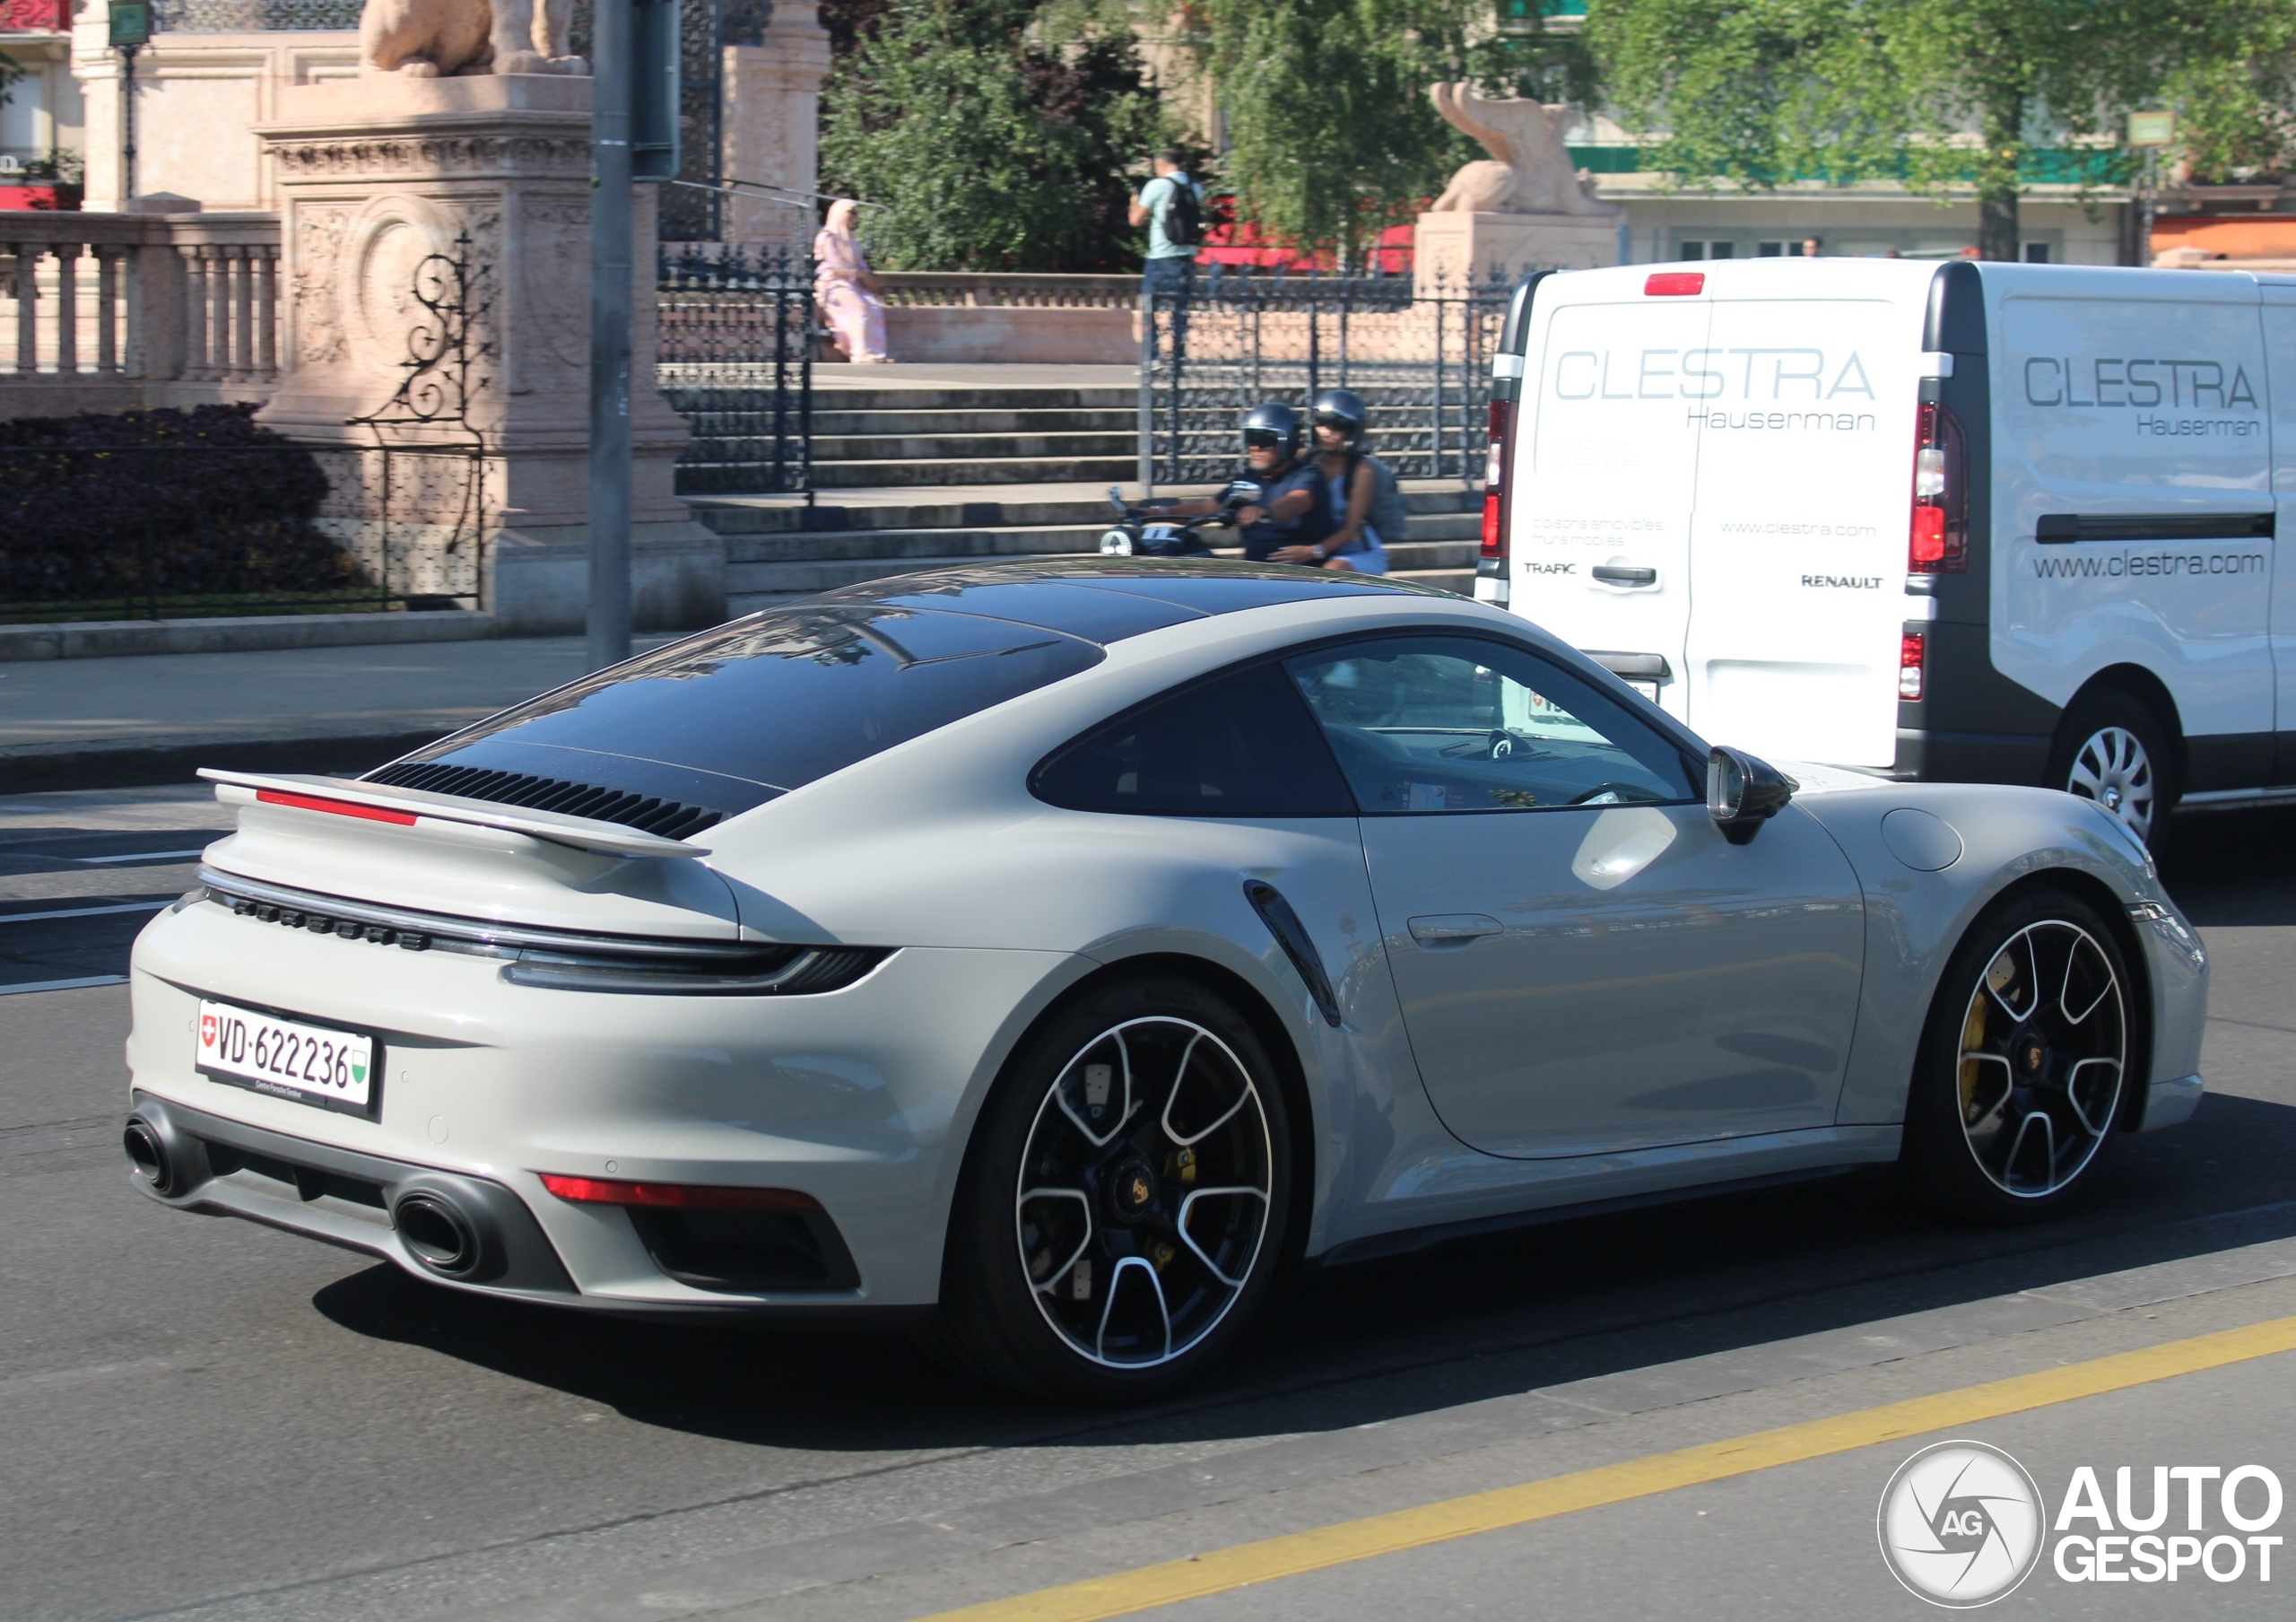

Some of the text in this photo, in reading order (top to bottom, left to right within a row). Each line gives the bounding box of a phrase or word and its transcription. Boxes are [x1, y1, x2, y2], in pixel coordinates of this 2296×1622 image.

[1555, 348, 1876, 401] CLESTRA
[2024, 357, 2258, 408] CLESTRA
[1687, 406, 1876, 431] Hauserman
[2136, 414, 2261, 436] Hauserman
[1590, 518, 1664, 530] amovibles
[1720, 521, 1876, 536] www.clestra.com
[1532, 534, 1624, 546] murs mobiles
[1525, 562, 1577, 575] TRAFIC
[2033, 550, 2265, 578] www.clestra.com
[1801, 574, 1883, 589] RENAULT
